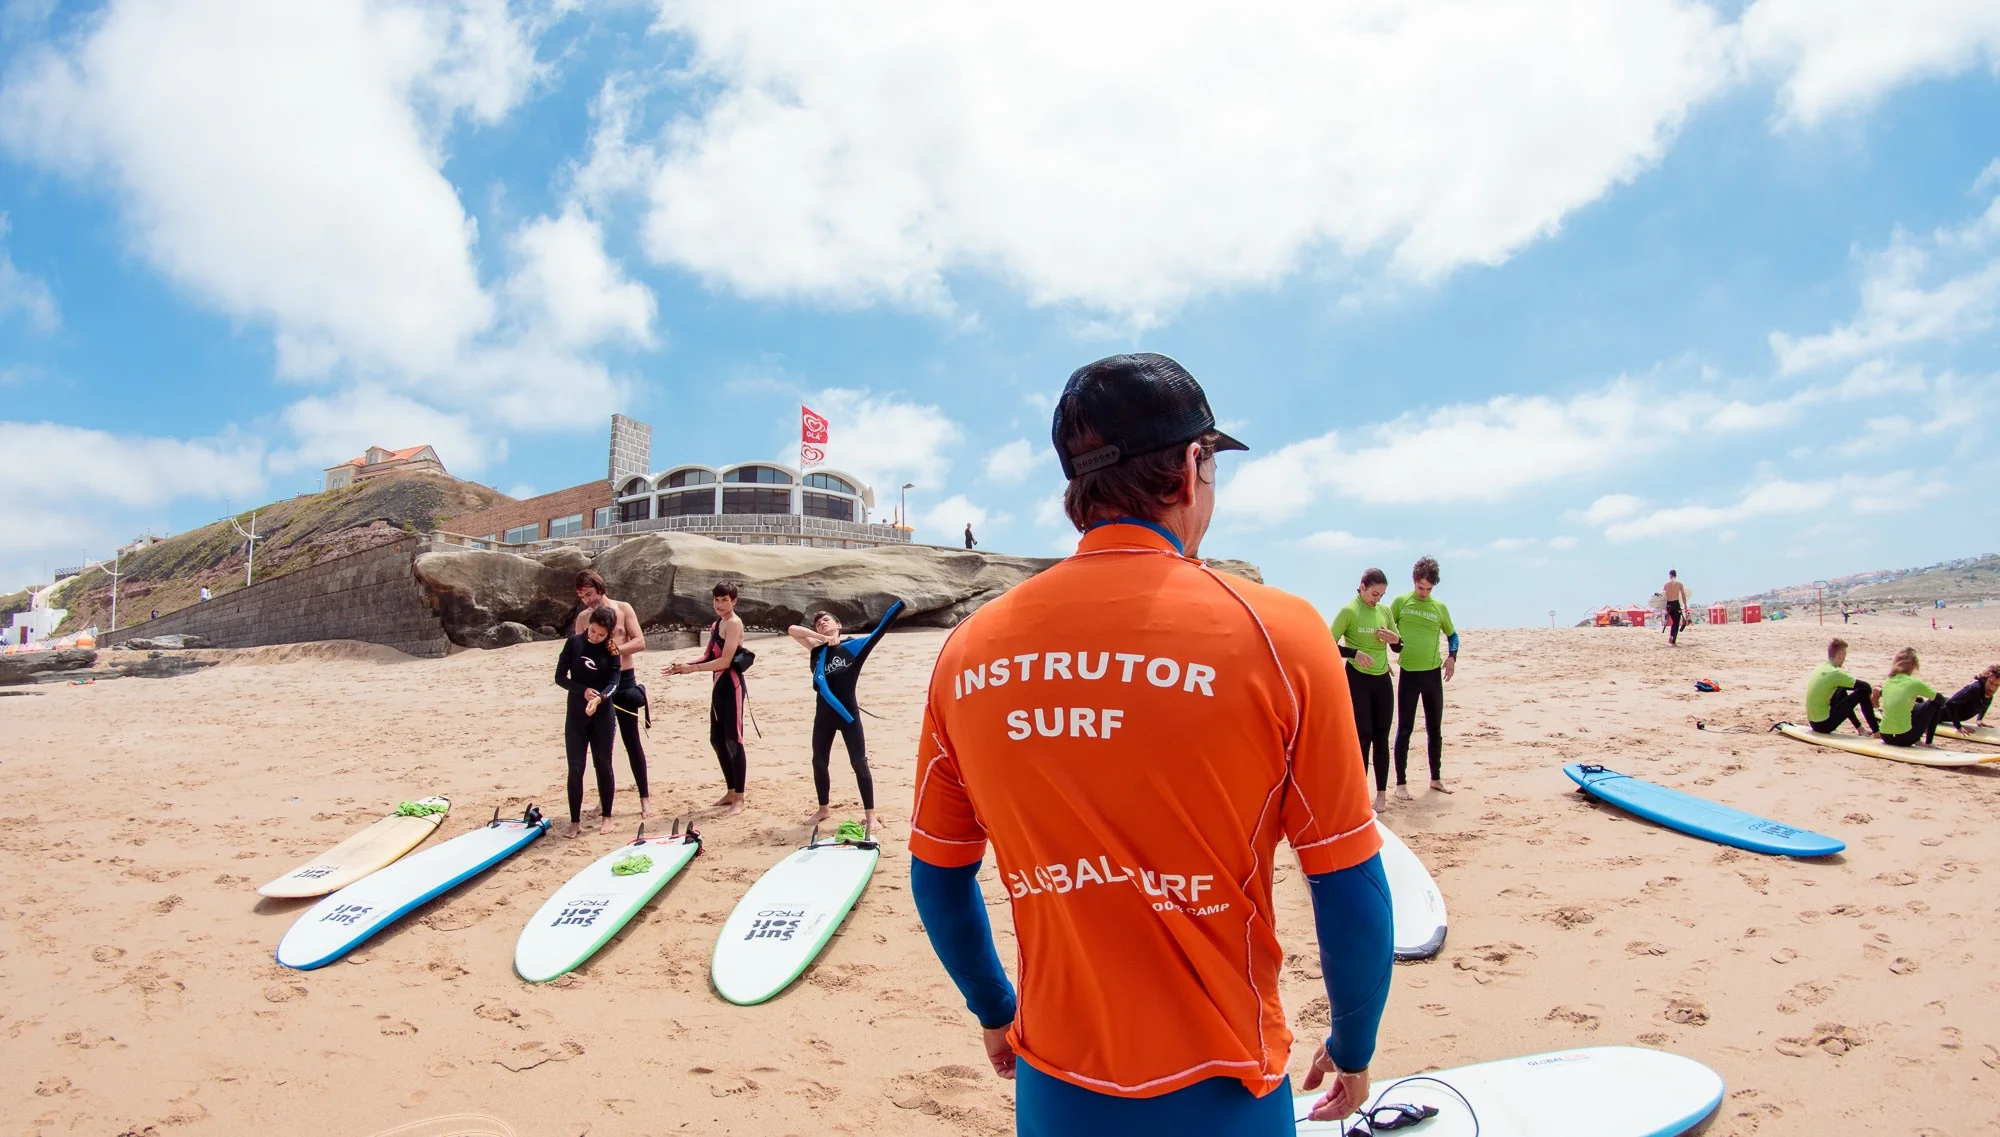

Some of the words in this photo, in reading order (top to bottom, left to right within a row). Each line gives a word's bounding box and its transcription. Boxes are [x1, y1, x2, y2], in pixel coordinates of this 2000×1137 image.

[955, 651, 1217, 700] INSTRUTOR
[1007, 707, 1125, 741] SURF
[567, 899, 610, 907] PRO
[560, 908, 604, 918] Soft
[1186, 903, 1230, 916] CAMP
[318, 912, 360, 925] Surf
[550, 917, 597, 928] Surf
[752, 919, 801, 930] Soft
[743, 929, 796, 941] Surf
